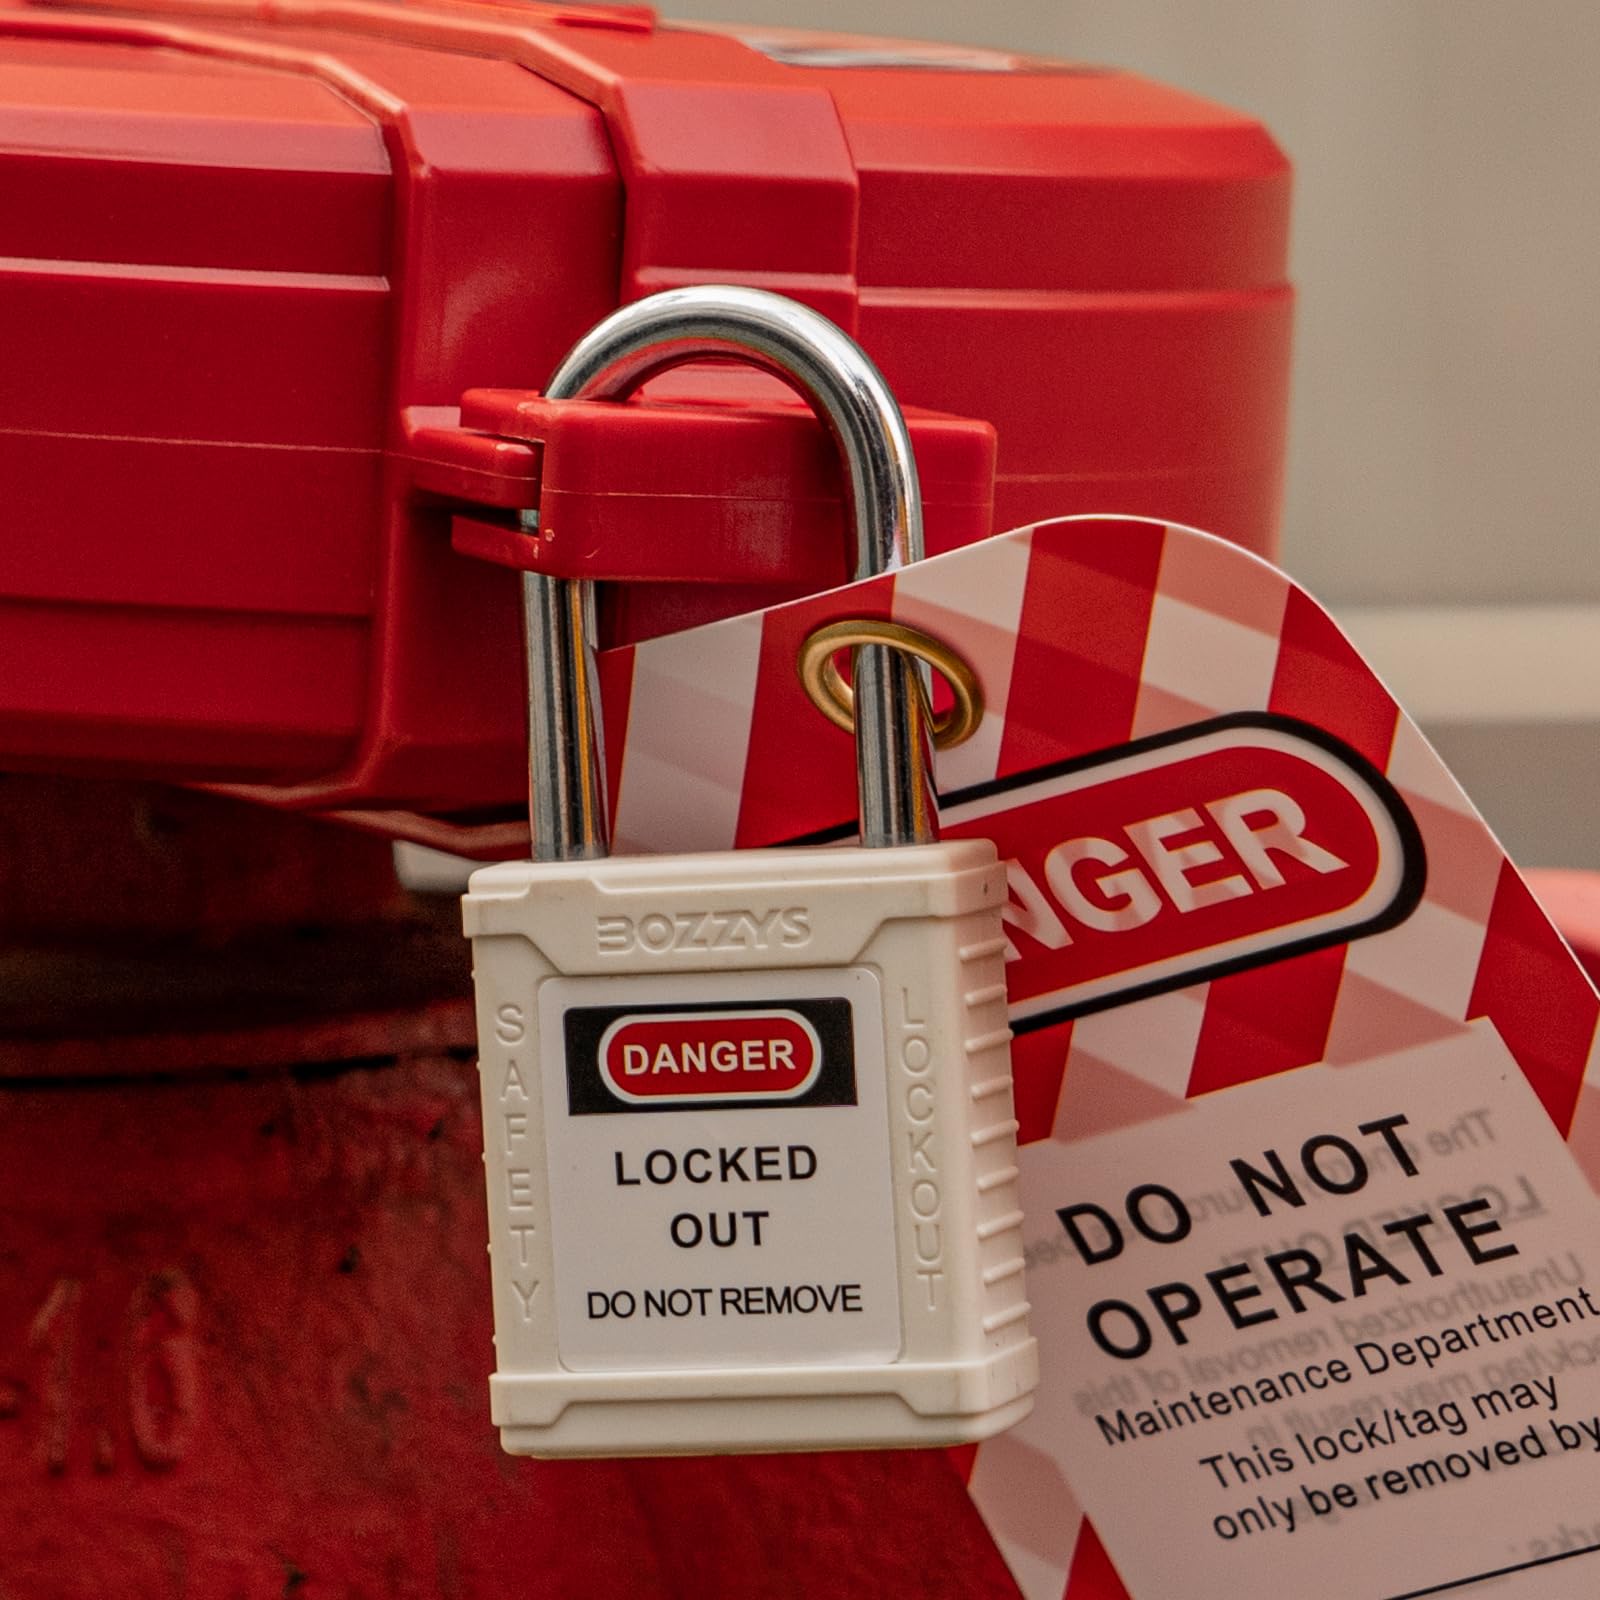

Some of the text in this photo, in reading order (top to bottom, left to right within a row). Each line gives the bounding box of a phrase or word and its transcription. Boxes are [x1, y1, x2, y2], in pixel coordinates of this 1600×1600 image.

[597, 907, 812, 955] BOZZYS
[1000, 787, 1350, 964] NGER
[623, 1039, 796, 1075] DANGER
[496, 1003, 539, 1322] SAFETY
[614, 1145, 817, 1186] LOCKED
[903, 987, 943, 1311] LOCKOUT
[1056, 1183, 1192, 1266] DO
[1229, 1114, 1419, 1217] NOT
[670, 1211, 770, 1249] OUT
[1086, 1198, 1519, 1360] OPERATE
[587, 1284, 863, 1320] DO NOT REMOVE
[1095, 1286, 1600, 1445] Maintenance Department
[1199, 1375, 1558, 1488] This lock/tag may
[1213, 1416, 1600, 1540] only be removed by
